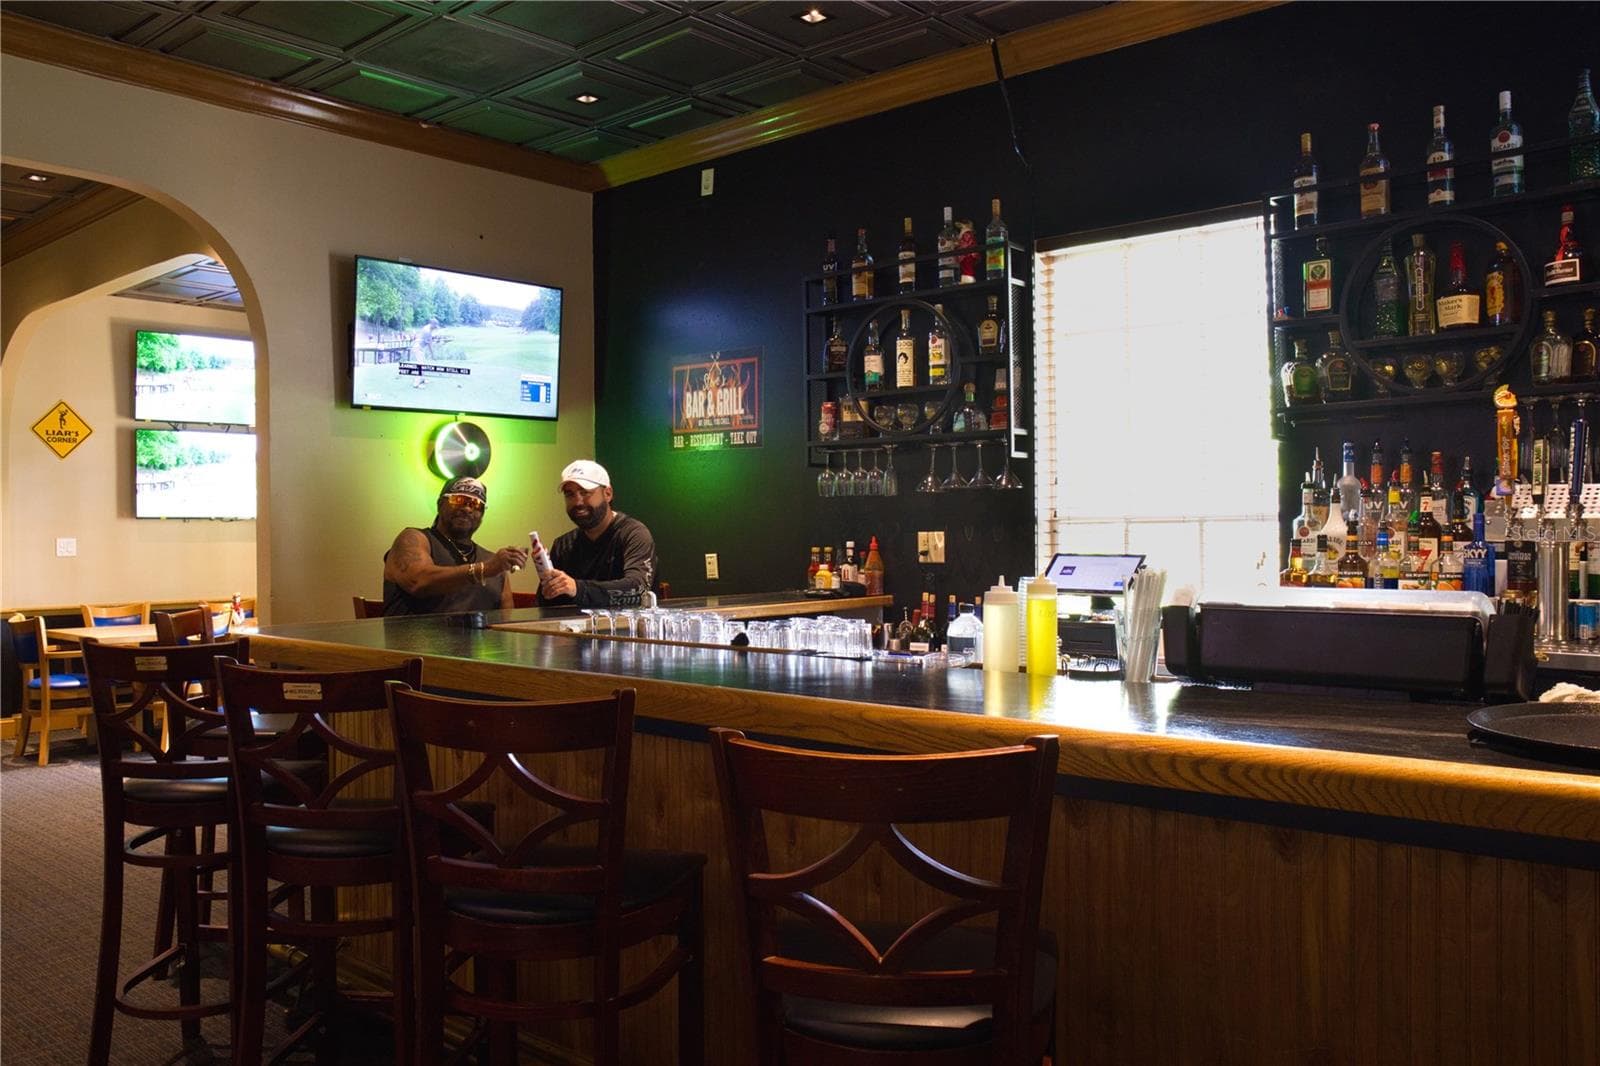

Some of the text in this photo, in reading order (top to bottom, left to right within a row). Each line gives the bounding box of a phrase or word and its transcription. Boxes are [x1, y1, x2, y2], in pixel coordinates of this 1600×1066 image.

[686, 386, 745, 418] BAR & GRILL
[45, 429, 80, 437] LIAR'S
[46, 436, 78, 444] CORNER
[674, 431, 757, 448] BAR RESTAURANT TAKE OUT
[1365, 501, 1384, 510] UV
[1424, 501, 1430, 511] 7
[1463, 548, 1488, 558] SKYY
[1417, 549, 1432, 574] 7
